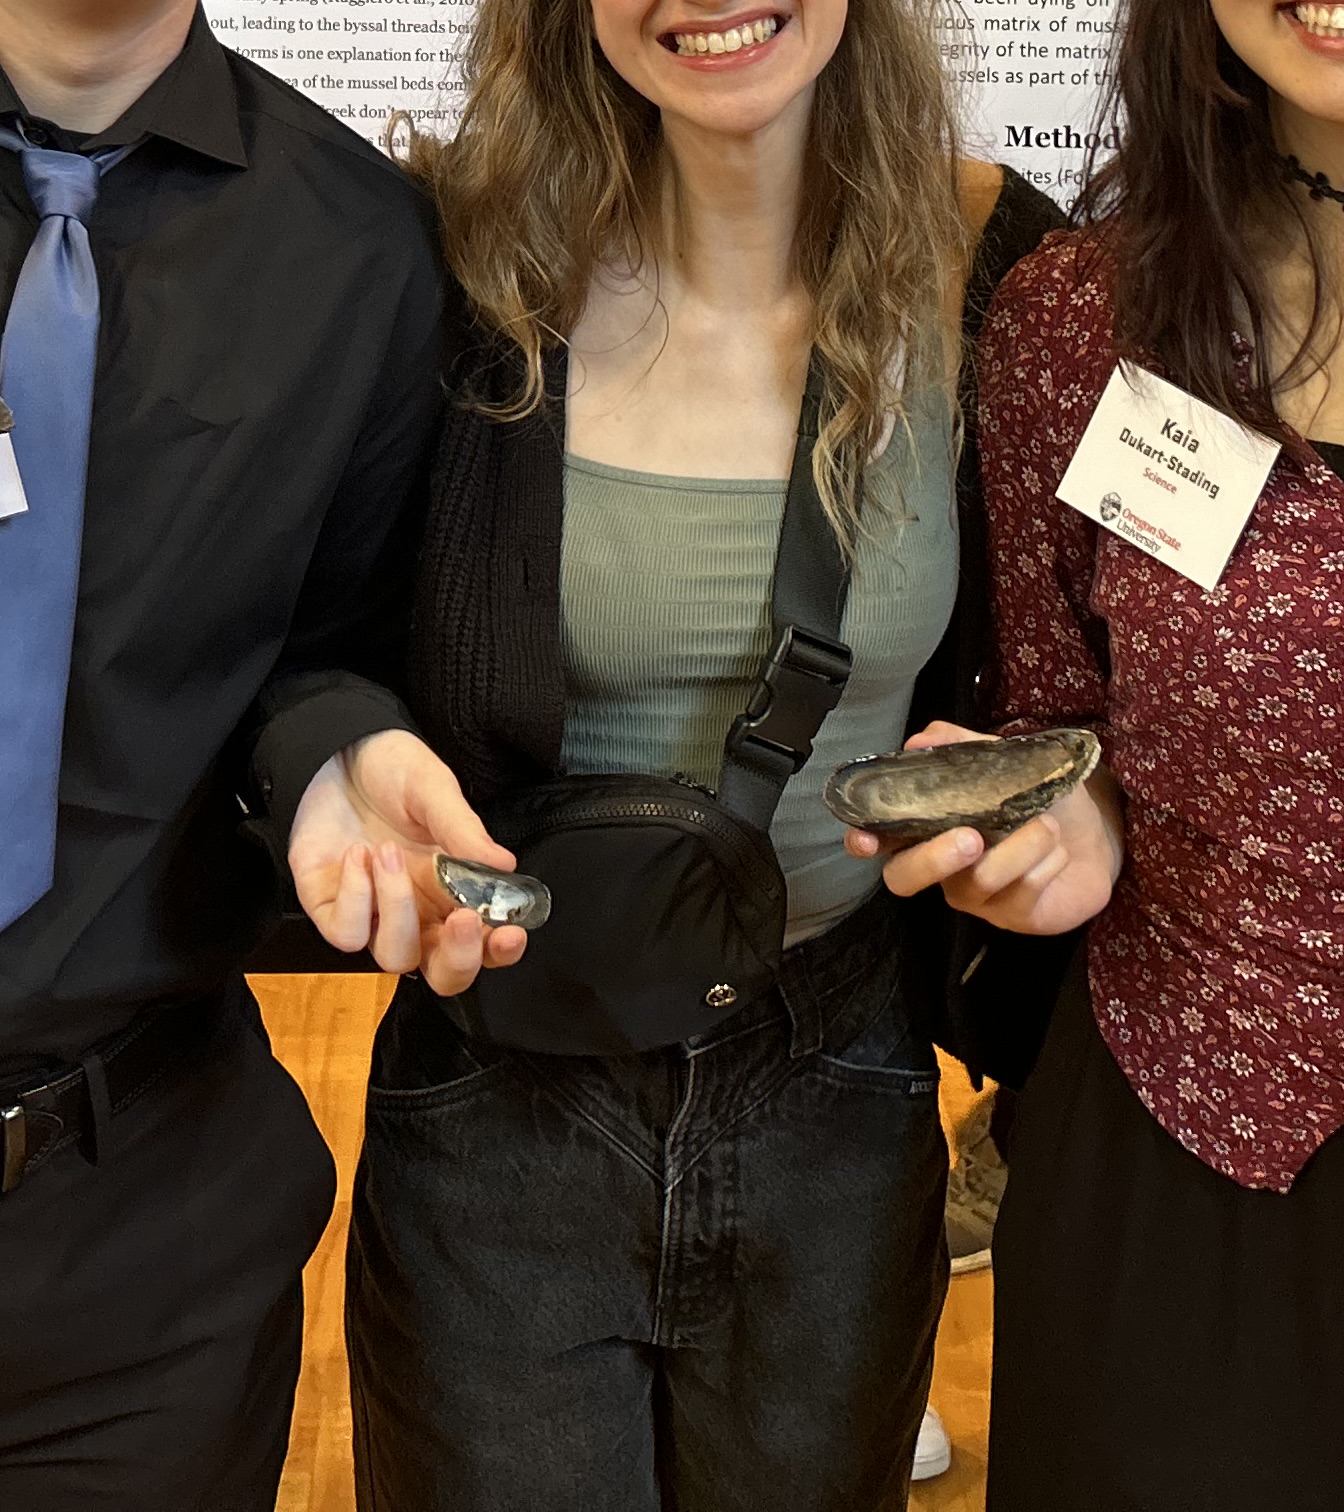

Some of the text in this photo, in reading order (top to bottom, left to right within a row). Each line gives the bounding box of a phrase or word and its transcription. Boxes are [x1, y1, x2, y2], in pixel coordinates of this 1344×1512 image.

[1160, 418, 1200, 454] Kaia
[1119, 427, 1220, 500] Dukart-Stading
[1142, 467, 1177, 495] Science
[1116, 519, 1161, 554] University
[1122, 507, 1182, 551] Oregon State
